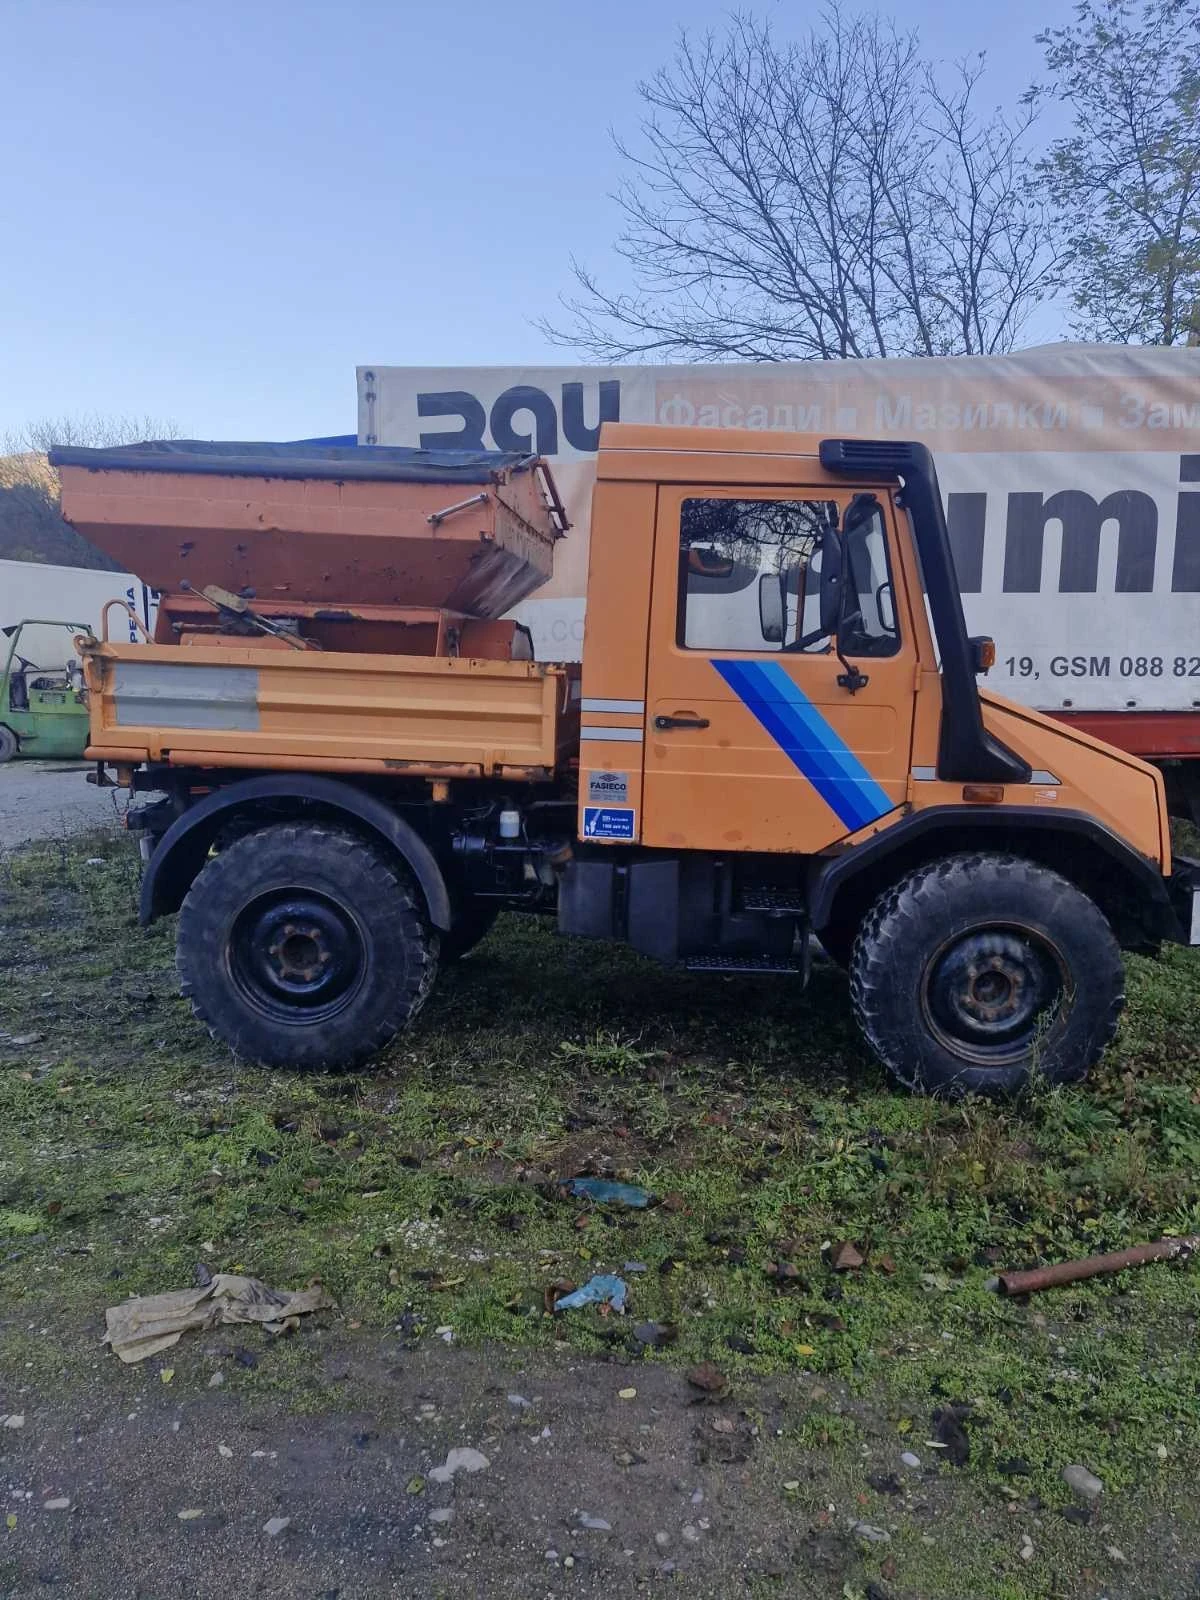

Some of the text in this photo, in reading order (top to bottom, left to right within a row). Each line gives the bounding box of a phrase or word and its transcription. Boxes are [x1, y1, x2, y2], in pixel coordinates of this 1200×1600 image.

[659, 393, 824, 432] Фасади
[875, 391, 1069, 432] Мазилки
[1005, 656, 1040, 680] 19,
[1050, 656, 1111, 677] GSM
[1119, 656, 1164, 677] 088
